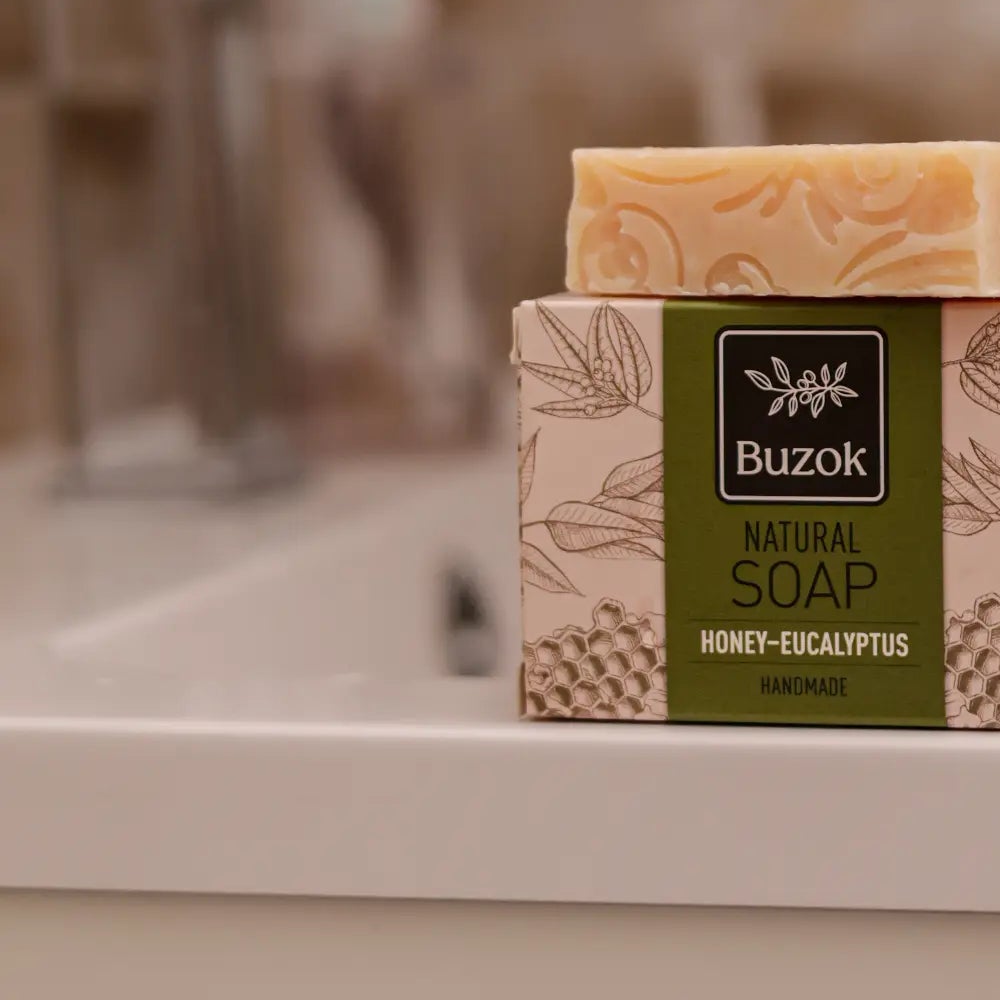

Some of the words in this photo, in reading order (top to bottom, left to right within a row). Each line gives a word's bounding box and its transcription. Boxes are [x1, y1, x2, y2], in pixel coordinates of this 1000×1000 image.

[736, 440, 867, 477] Buzok
[744, 521, 861, 553] NATURAL
[731, 560, 877, 609] SOAP
[700, 629, 909, 657] HONEY-EUCALYPTUS
[760, 675, 848, 697] HANDMADE
